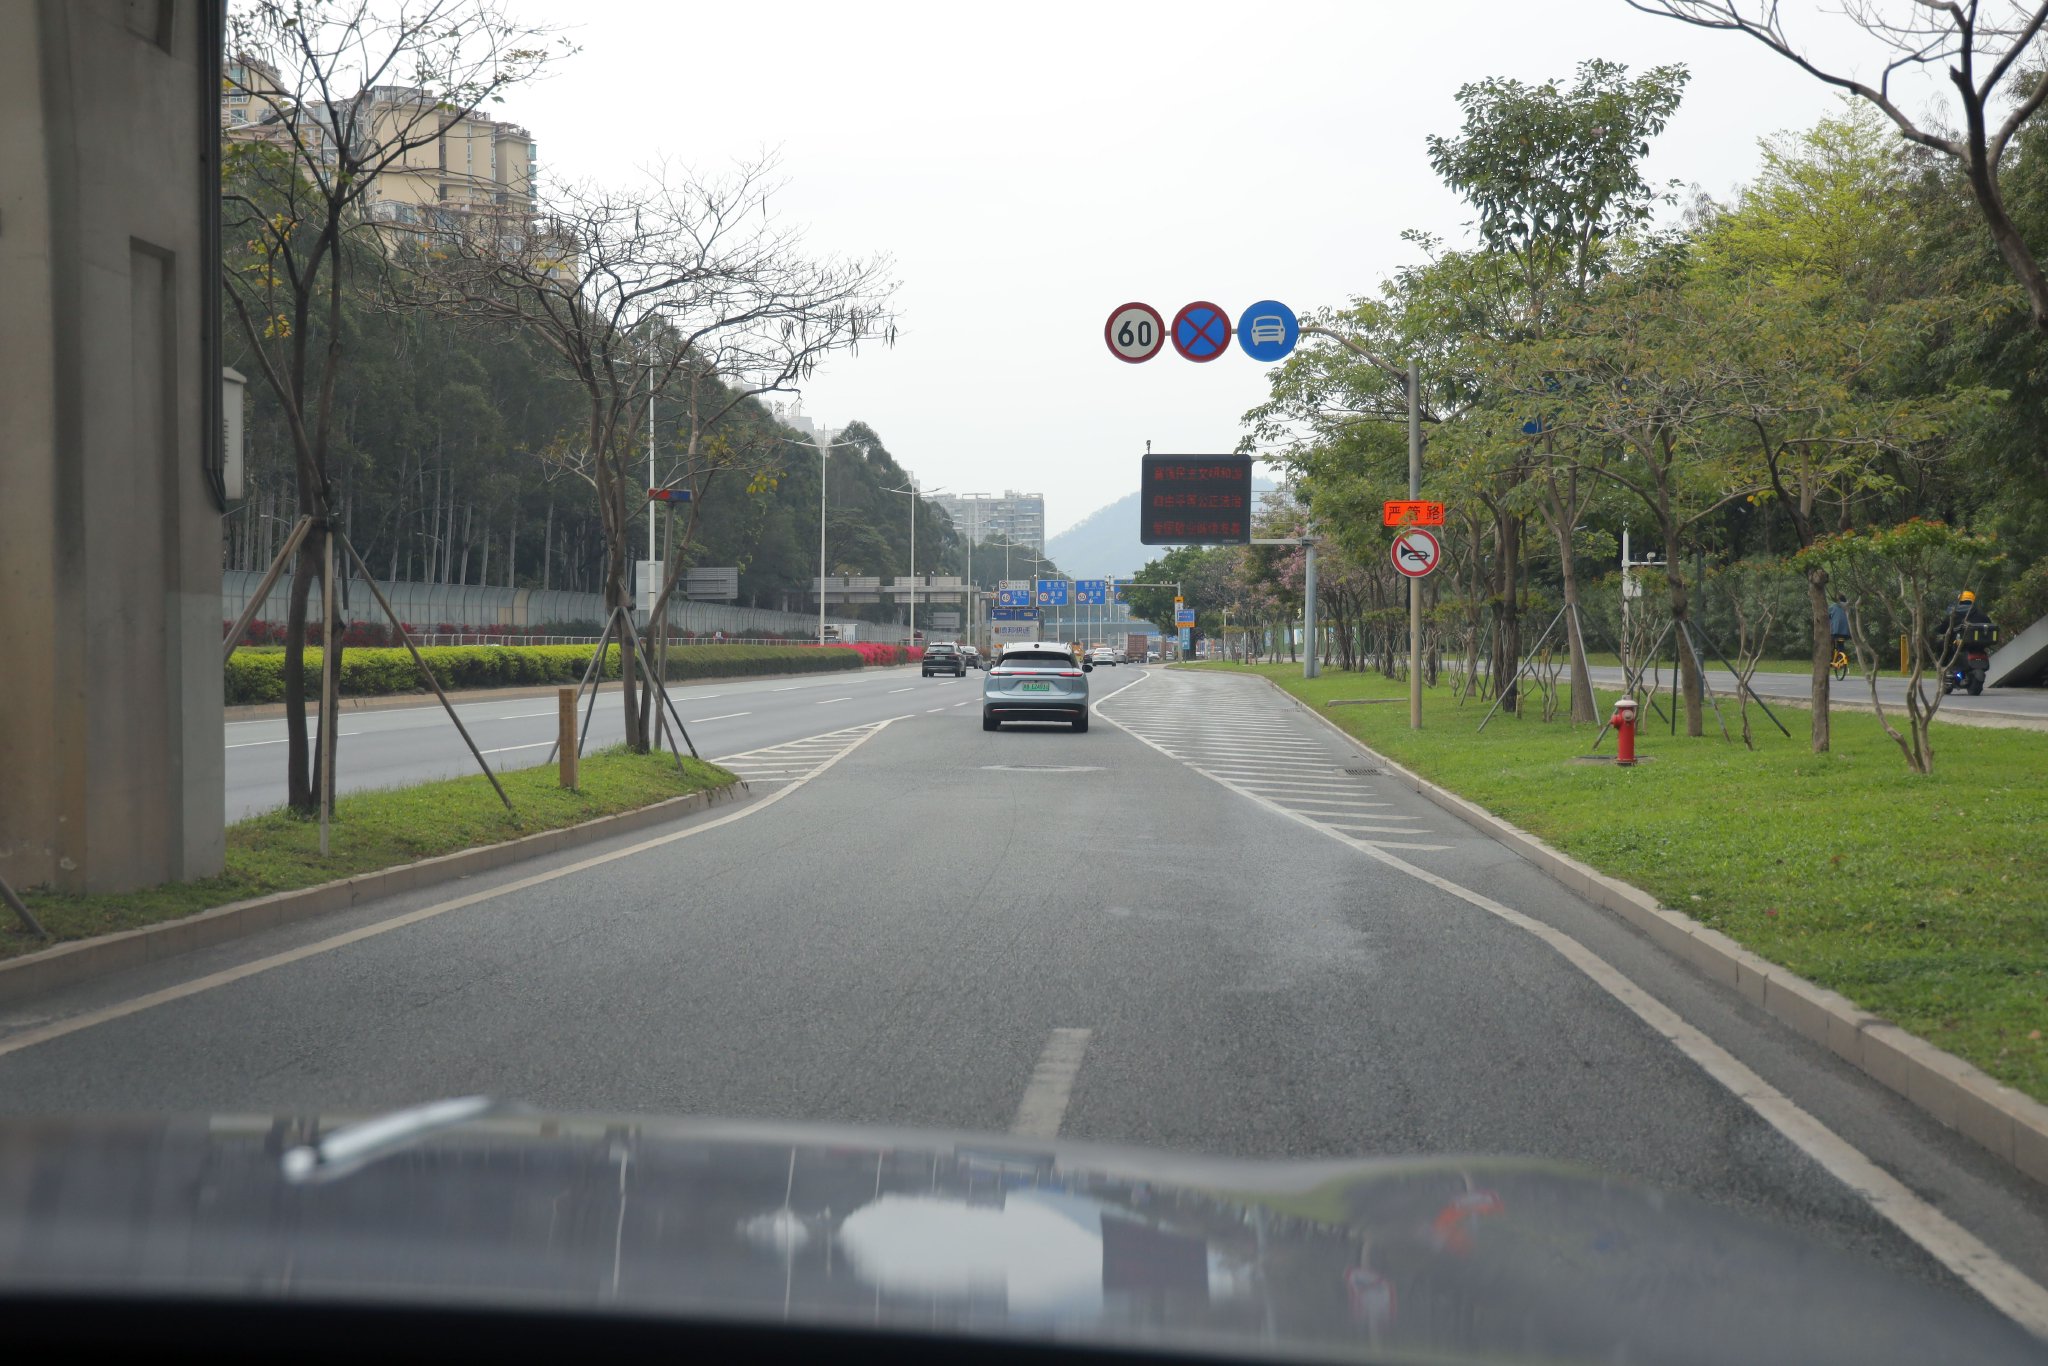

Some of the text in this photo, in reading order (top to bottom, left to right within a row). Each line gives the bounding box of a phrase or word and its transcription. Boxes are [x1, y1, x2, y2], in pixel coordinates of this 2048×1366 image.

[1117, 320, 1152, 347] 60
[1388, 505, 1440, 521] 严管路
